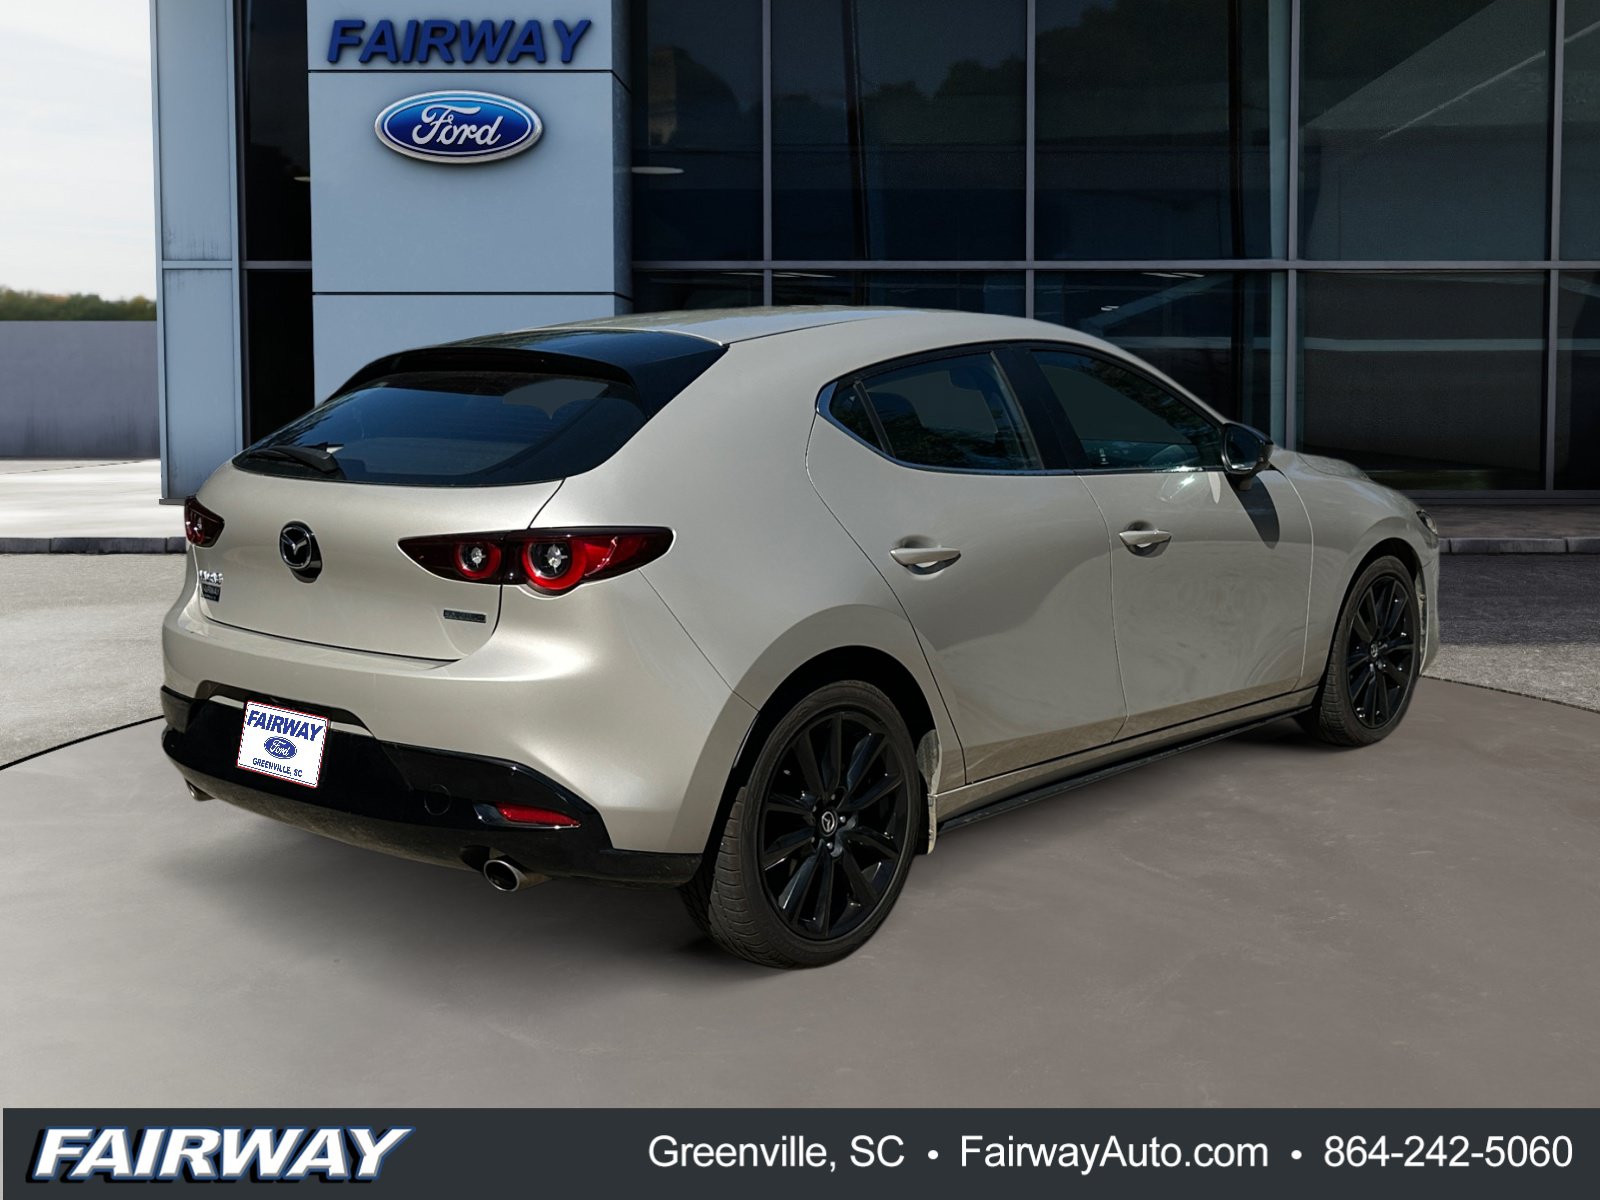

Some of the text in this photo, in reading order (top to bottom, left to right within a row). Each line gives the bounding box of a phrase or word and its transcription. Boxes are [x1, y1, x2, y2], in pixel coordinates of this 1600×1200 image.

[328, 20, 591, 63] FAIRWAY
[412, 105, 503, 145] Ford
[247, 710, 324, 741] FAIRWAY
[270, 740, 290, 756] Ford
[294, 769, 302, 777] SC
